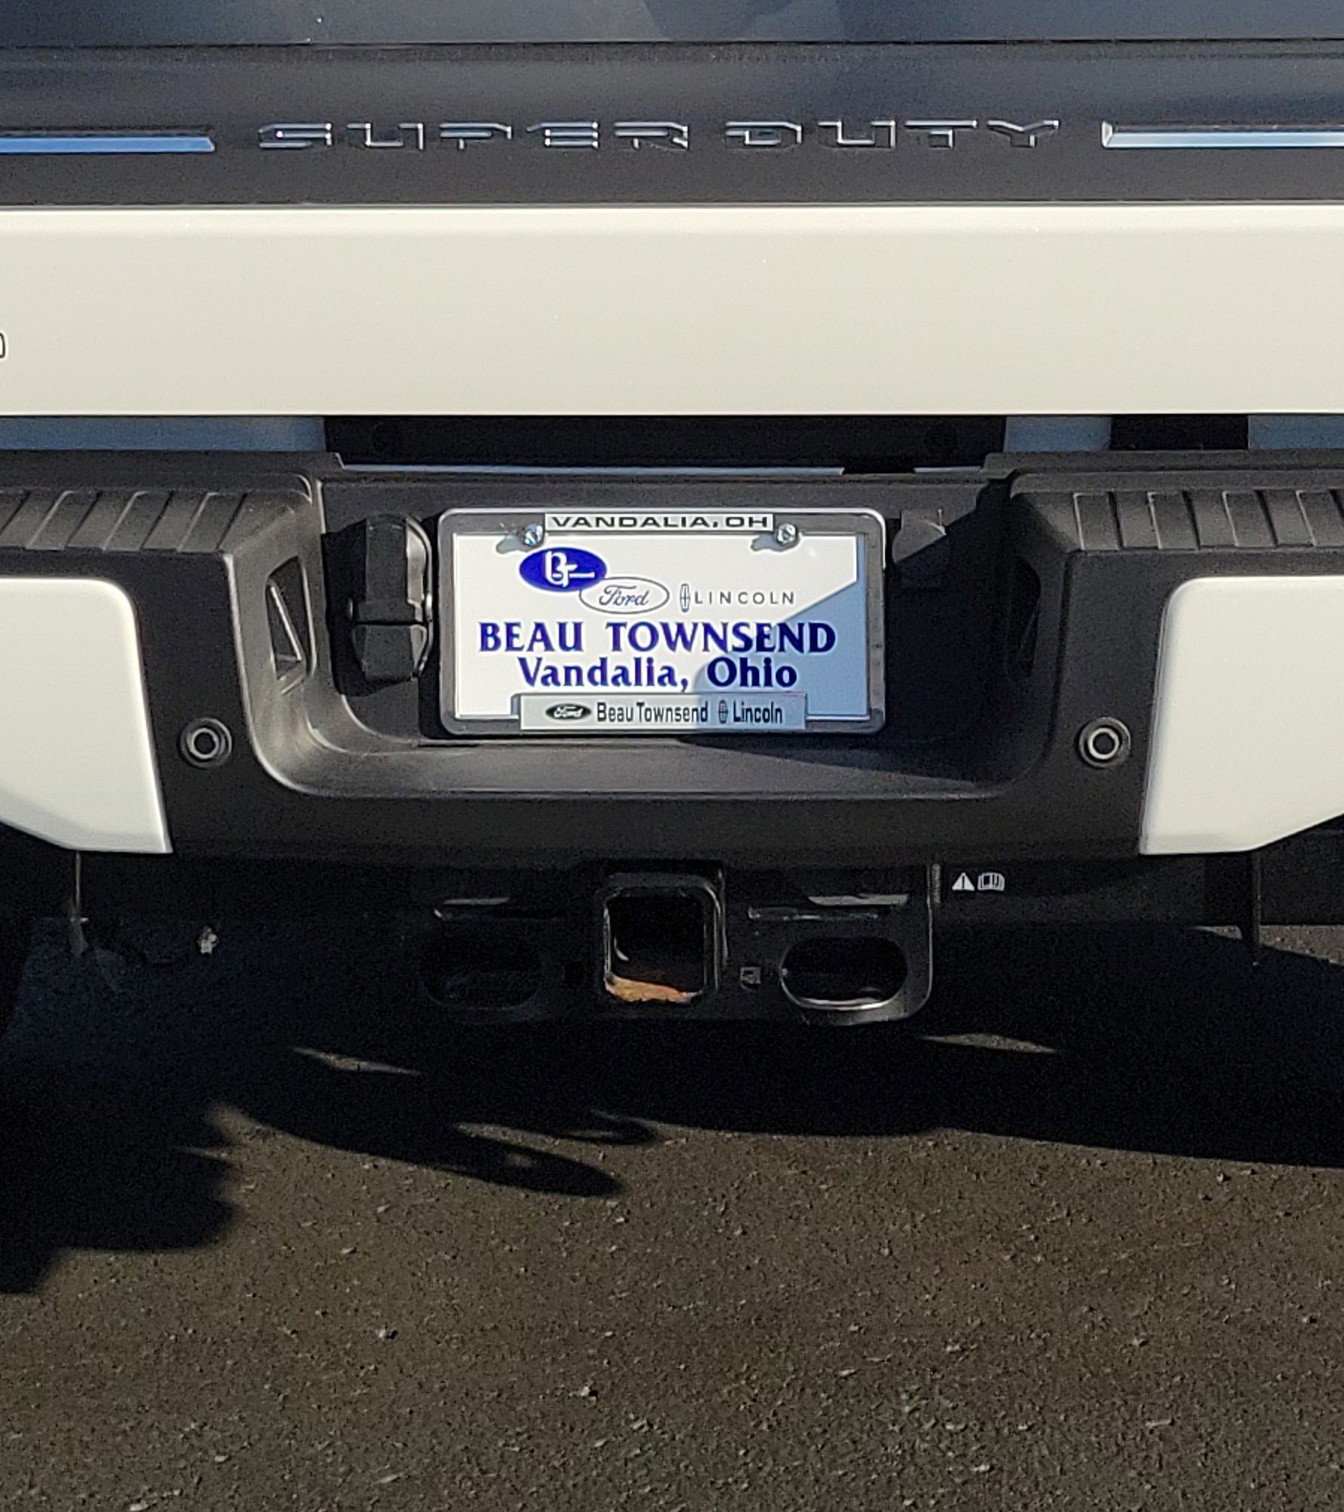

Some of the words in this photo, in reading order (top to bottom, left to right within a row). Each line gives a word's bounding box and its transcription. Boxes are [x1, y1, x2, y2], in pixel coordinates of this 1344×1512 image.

[258, 120, 689, 150] SUPER
[724, 119, 1059, 149] DUTY
[598, 586, 651, 607] Ford
[694, 591, 795, 606] LINCOLN
[479, 621, 585, 653] BEAU
[605, 621, 837, 653] TOWNSEND
[518, 656, 690, 693] Vandalia,
[707, 656, 798, 688] Ohio
[553, 704, 585, 719] Ford
[597, 702, 634, 723] Beau
[636, 701, 709, 723] Townsend
[733, 701, 783, 723] Lincoln
